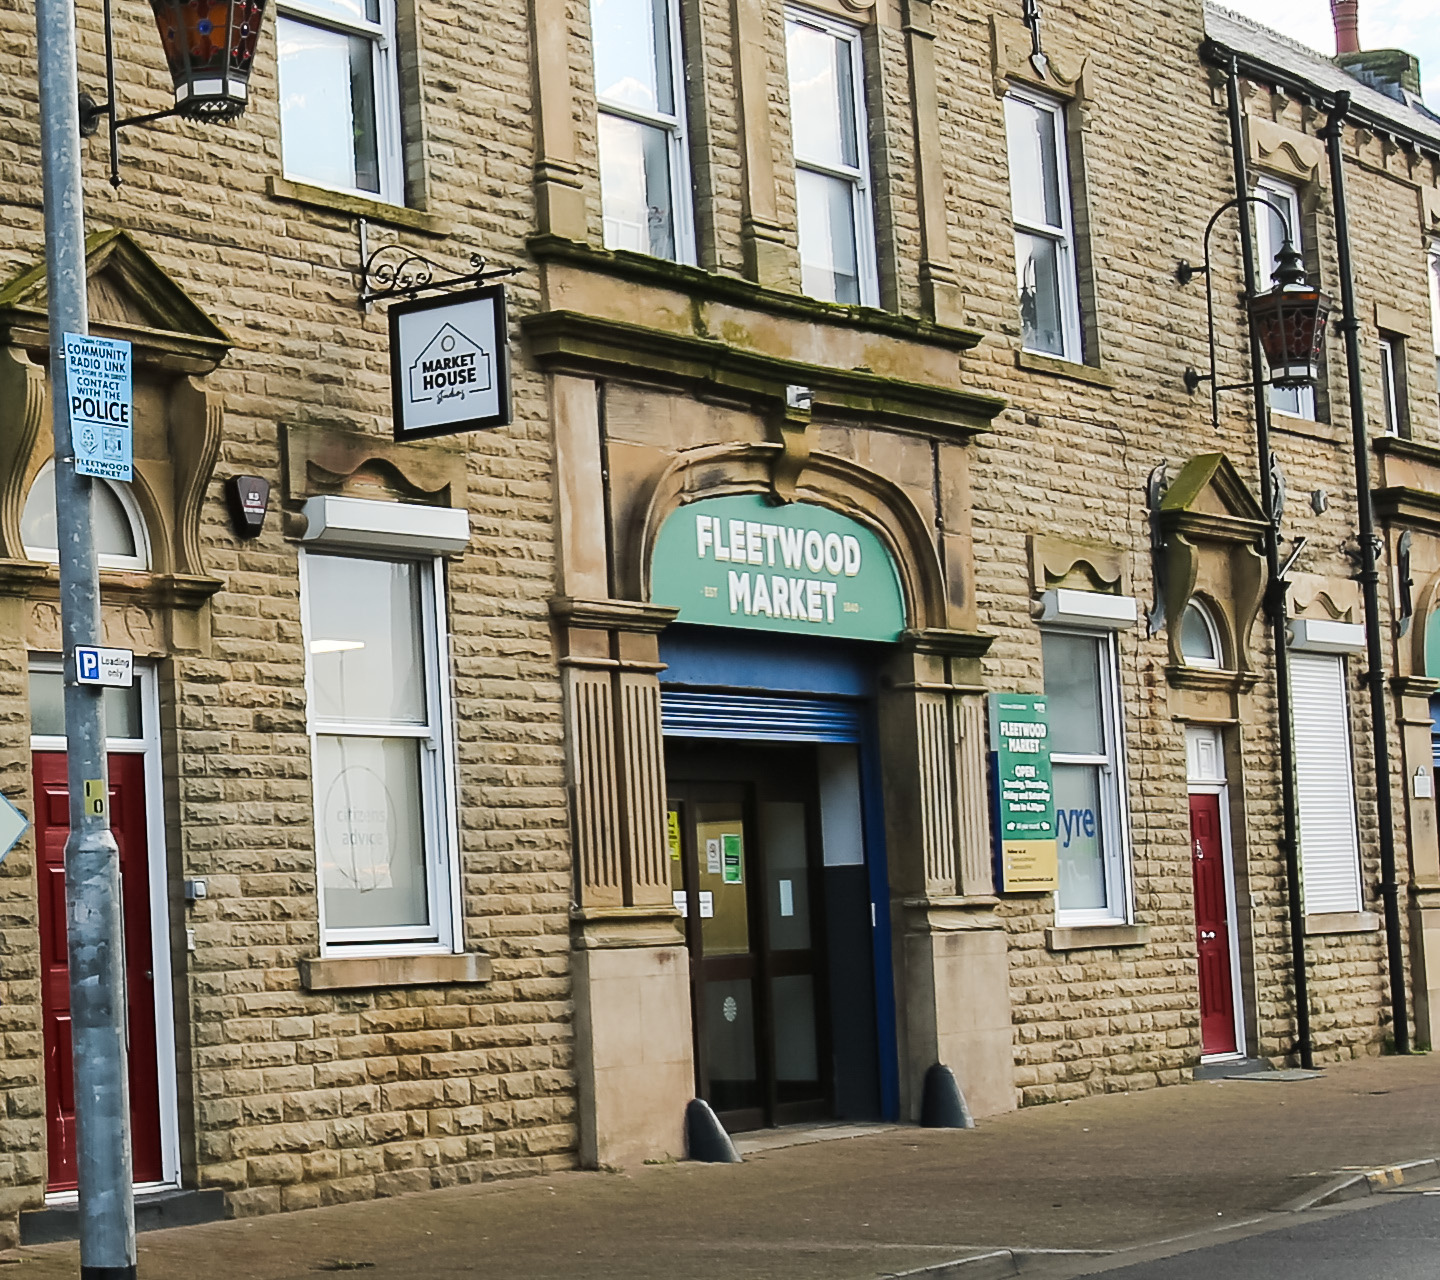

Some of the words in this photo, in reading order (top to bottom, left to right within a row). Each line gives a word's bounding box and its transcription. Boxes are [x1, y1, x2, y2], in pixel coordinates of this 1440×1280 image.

[67, 343, 128, 361] COMMUNITY
[70, 356, 101, 370] RADIO
[104, 361, 126, 373] LINK
[422, 352, 476, 374] MARKET
[77, 377, 120, 391] CONTACT
[423, 367, 477, 391] HOUSE
[77, 386, 101, 397] WITH
[104, 390, 121, 401] THE
[72, 396, 129, 423] POLICE
[77, 458, 130, 472] FLEETWOOD
[85, 467, 121, 478] MARKET
[696, 514, 862, 577] FLEETWOOD
[728, 570, 837, 623] MARKET
[83, 653, 97, 677] P
[101, 656, 130, 668] Loading
[108, 669, 123, 679] only
[1000, 722, 1047, 737] FLEETWOOD
[1008, 738, 1040, 752] MARKET
[1015, 765, 1035, 778] OPEN
[337, 808, 385, 823] citizens
[342, 829, 383, 845] advice
